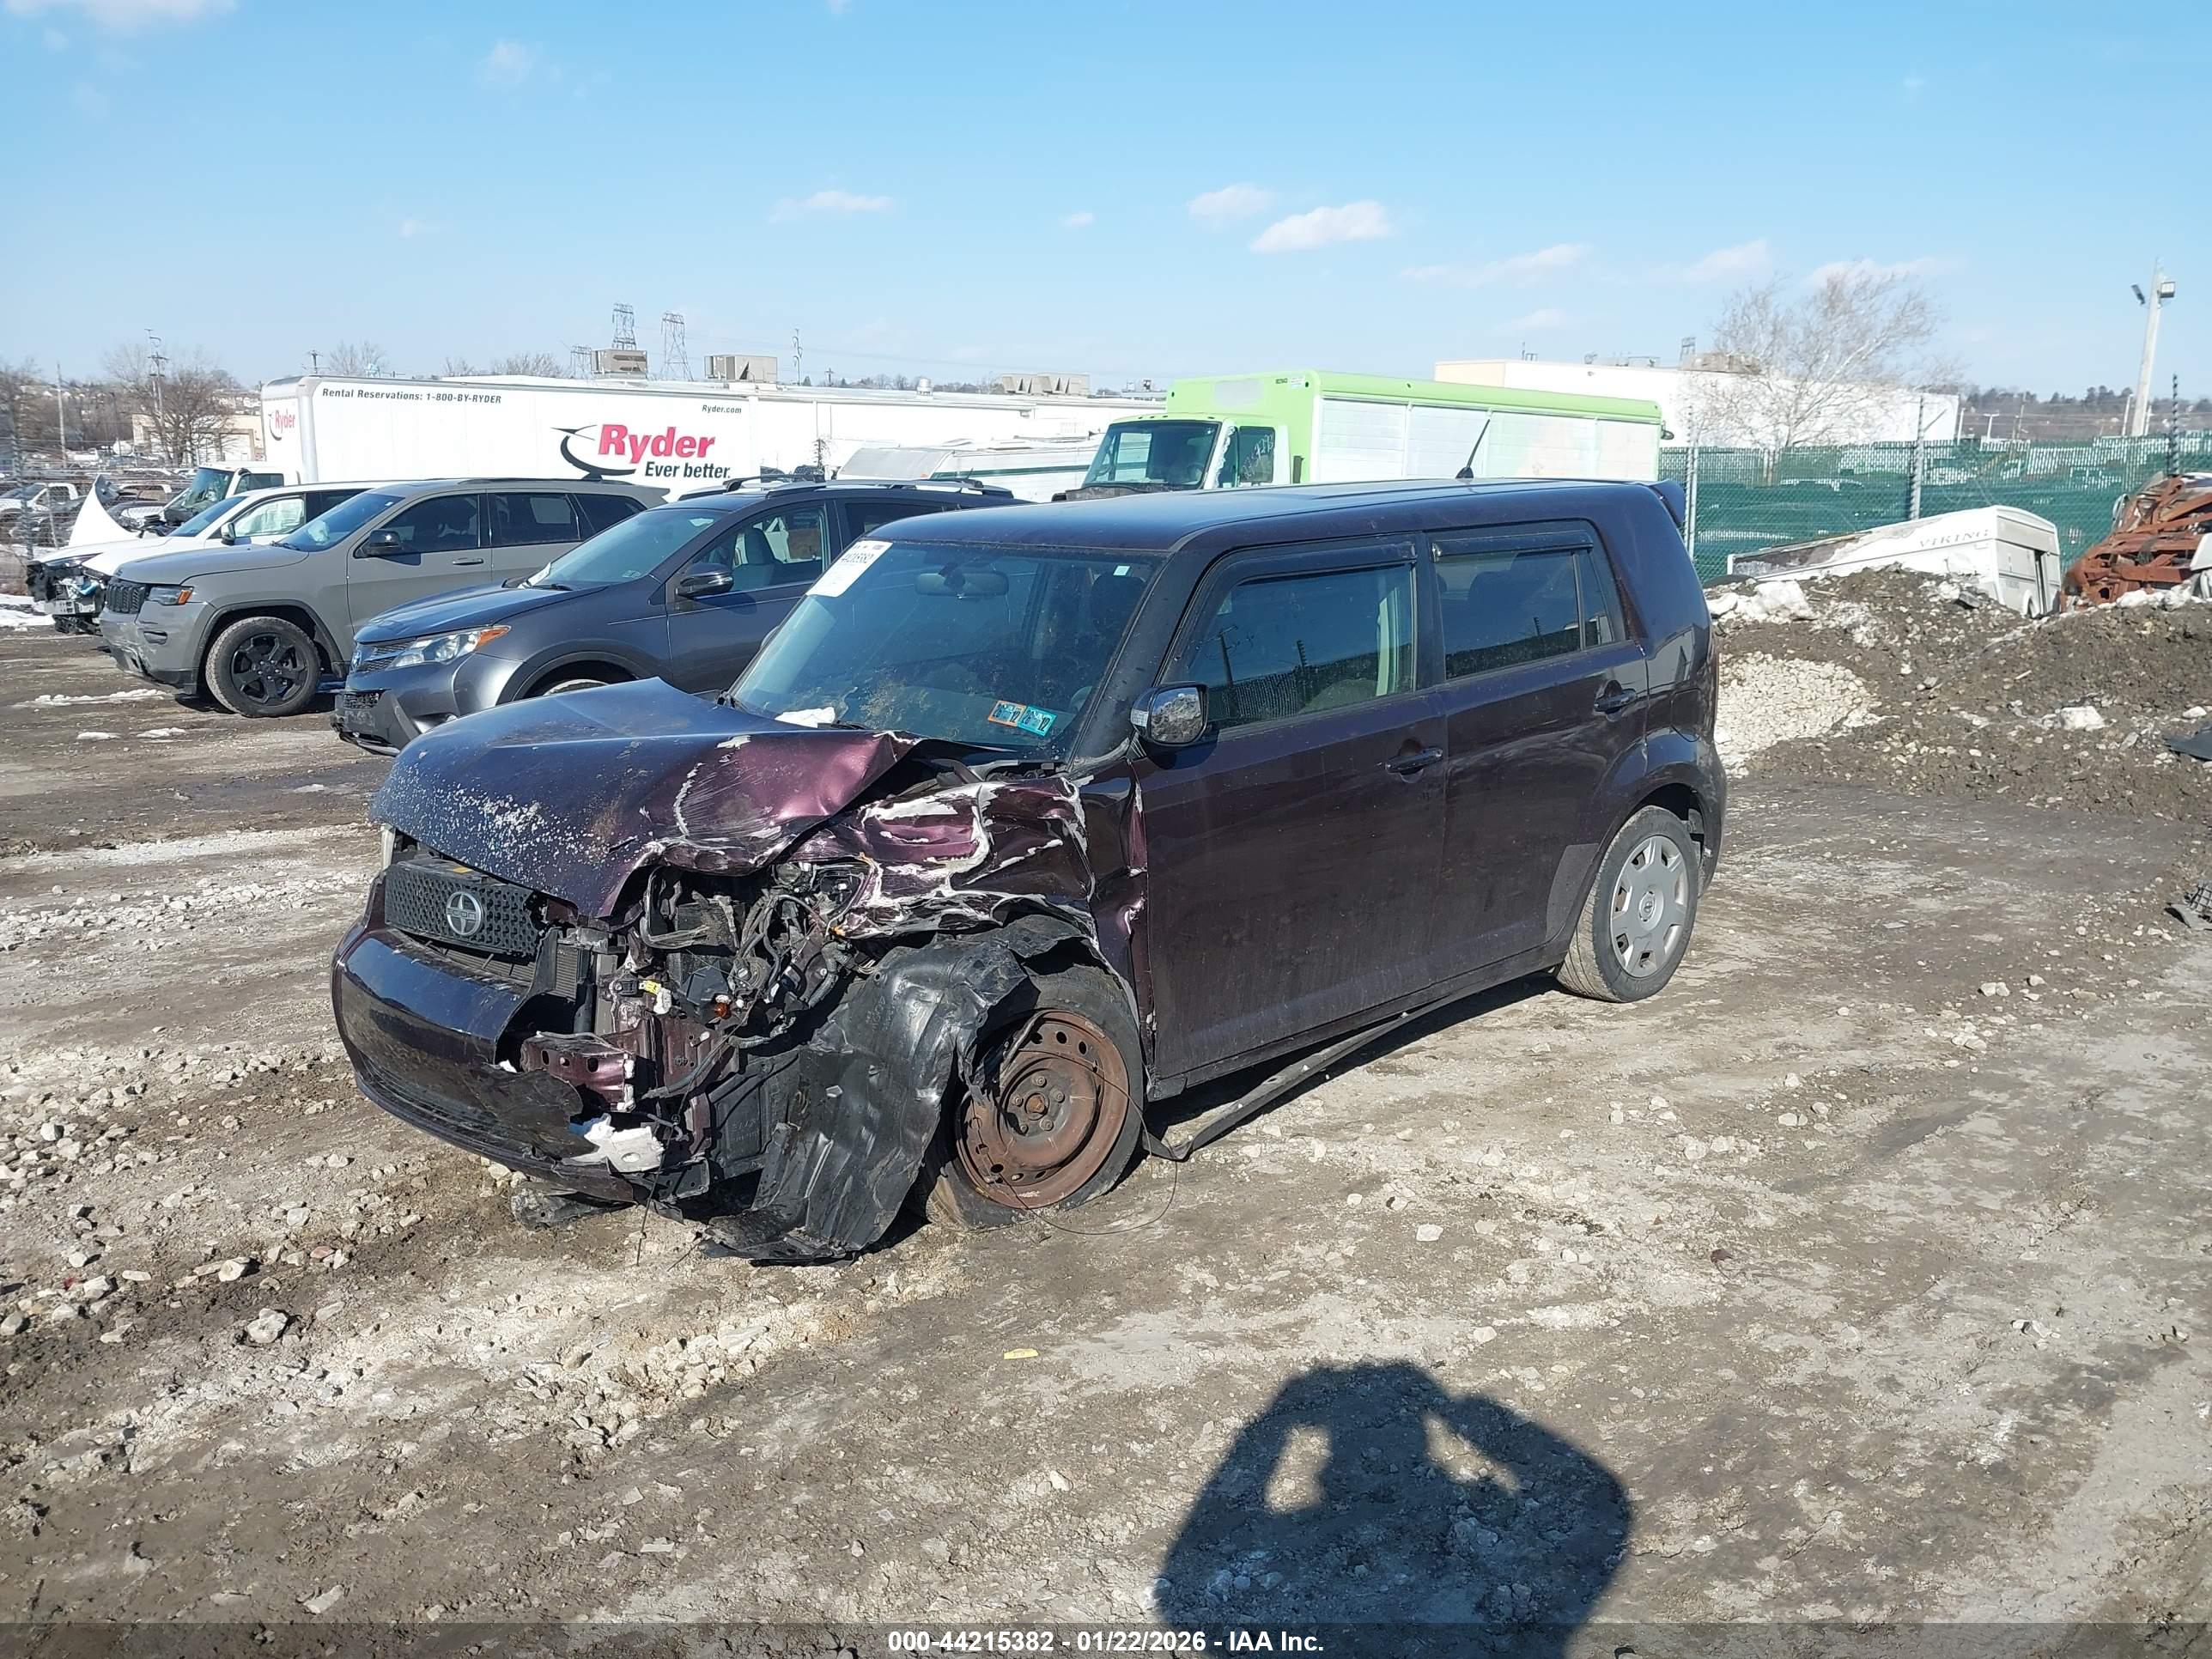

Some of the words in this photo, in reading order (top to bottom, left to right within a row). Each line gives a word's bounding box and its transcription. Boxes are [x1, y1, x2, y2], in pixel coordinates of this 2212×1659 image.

[322, 388, 354, 398] Rental
[357, 389, 422, 401] Reservations:
[427, 392, 501, 404] 1-800-BY-RYDER
[702, 404, 742, 414] Ryder.com
[275, 409, 295, 434] Ryder
[598, 424, 715, 464] Ryder
[645, 461, 680, 477] Ever
[684, 462, 731, 478] better.
[1919, 529, 1989, 547] VIKING
